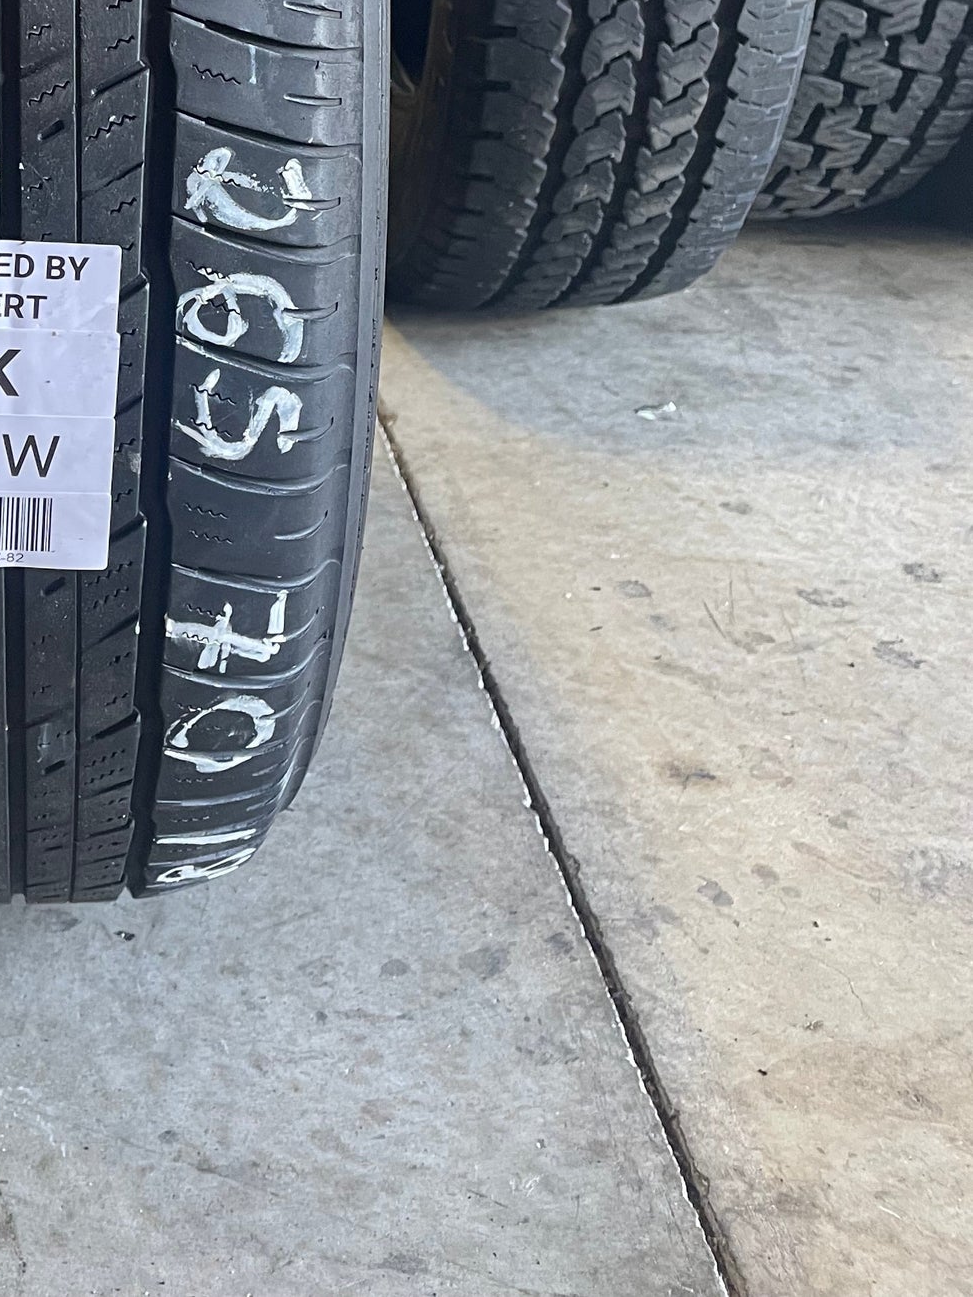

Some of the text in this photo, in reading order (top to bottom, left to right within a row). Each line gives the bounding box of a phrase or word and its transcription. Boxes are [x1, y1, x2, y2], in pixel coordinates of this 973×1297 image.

[45, 255, 91, 282] BY
[174, 145, 319, 459] 265
[164, 589, 289, 773] 70
